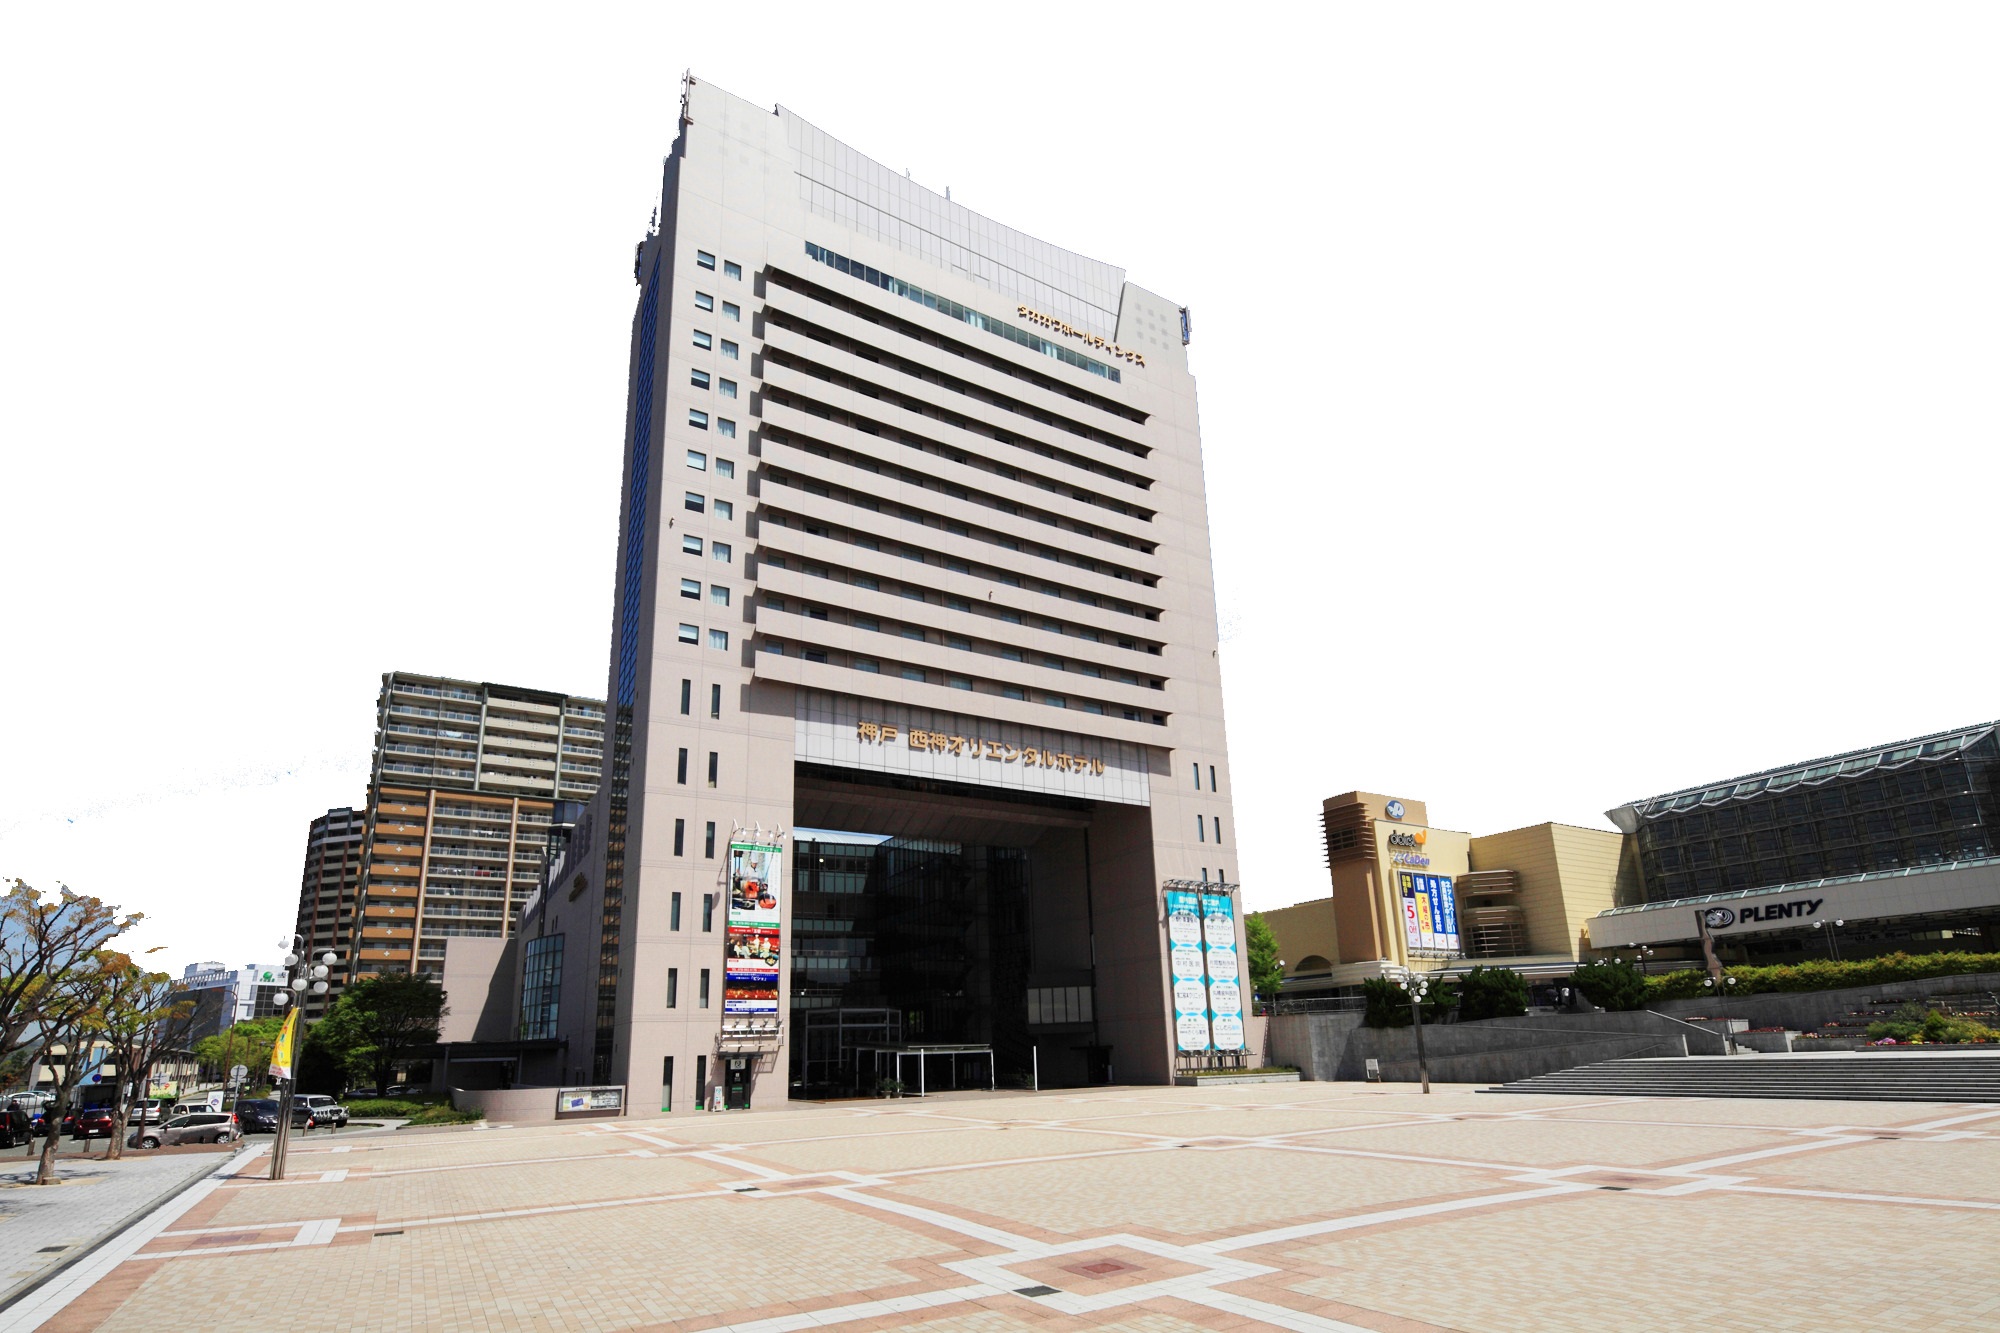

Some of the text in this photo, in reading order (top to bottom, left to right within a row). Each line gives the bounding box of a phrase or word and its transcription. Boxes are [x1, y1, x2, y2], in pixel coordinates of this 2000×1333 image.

[857, 720, 1106, 776] 神戸 西神オリエンタルホテル
[1406, 905, 1415, 919] 5
[1740, 898, 1823, 924] PLENTY
